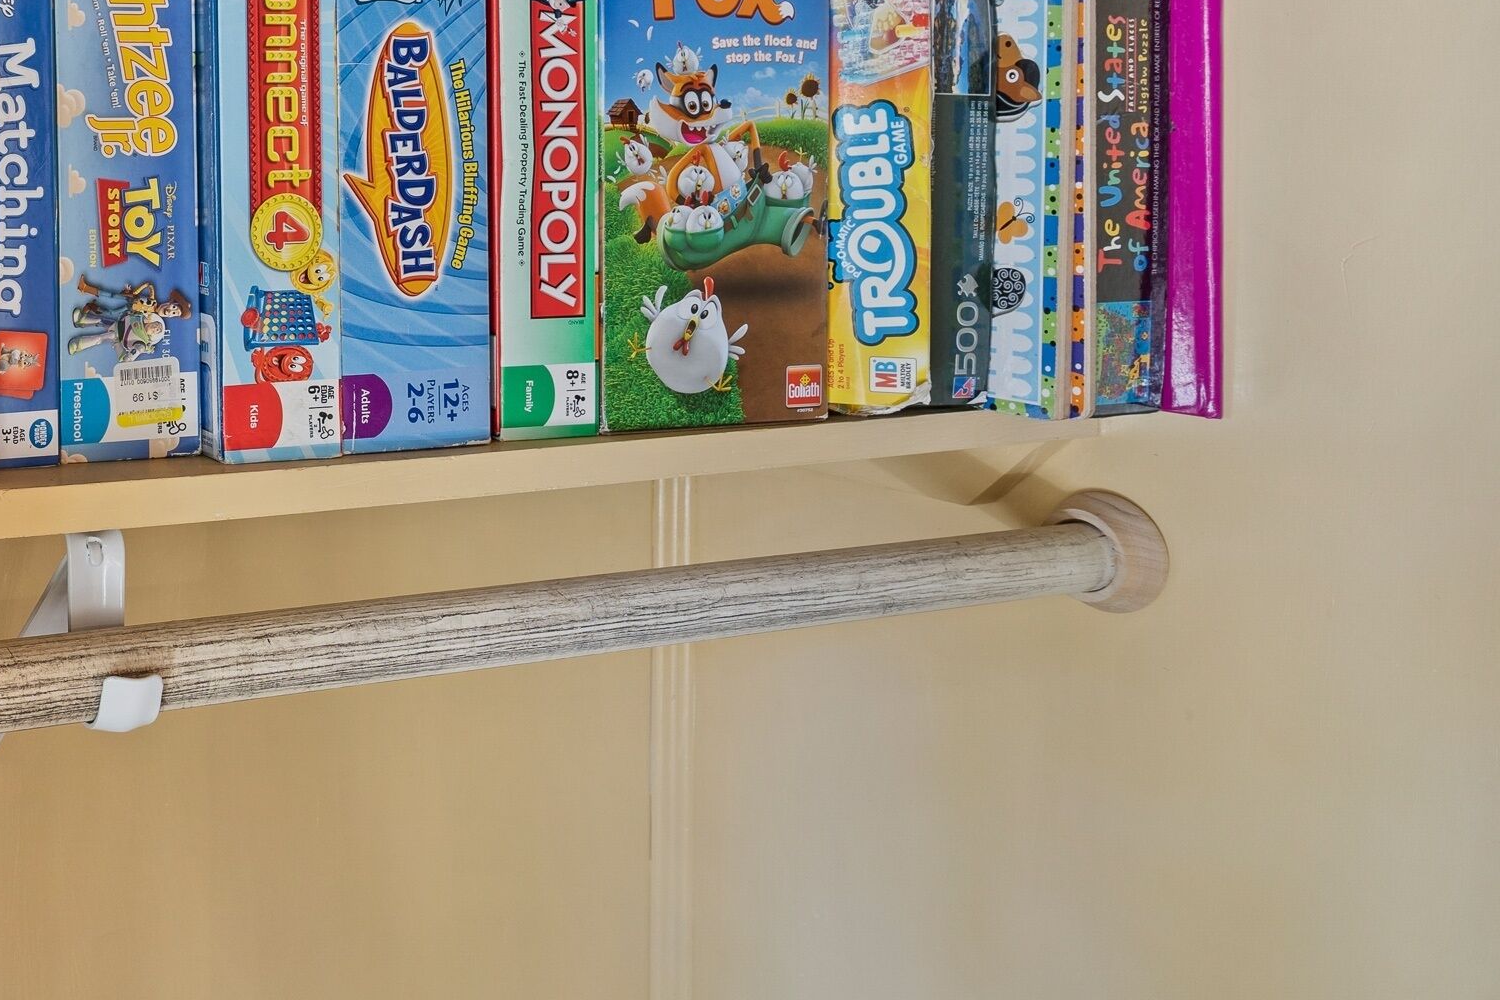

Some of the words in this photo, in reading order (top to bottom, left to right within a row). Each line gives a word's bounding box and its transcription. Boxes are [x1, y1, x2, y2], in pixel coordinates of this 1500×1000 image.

[712, 36, 739, 50] Save
[741, 34, 761, 48] the
[763, 35, 793, 48] flock
[796, 36, 818, 50] and
[726, 52, 751, 65] stop
[754, 50, 775, 64] the
[1098, 15, 1127, 102] States
[1137, 18, 1148, 62] Puzzle
[447, 57, 466, 90] The
[516, 59, 527, 78] The
[1136, 66, 1150, 113] Jigsaw
[448, 88, 478, 159] Hilarious
[515, 80, 530, 140] Fast-Dealing
[86, 113, 133, 159] Jr.
[384, 36, 436, 277] BALDERDASH
[890, 119, 908, 164] GAME
[517, 142, 528, 187] Property
[538, 11, 585, 308] MONOPOLY
[1097, 113, 1126, 207] United
[1124, 121, 1153, 230] America
[456, 160, 478, 225] Bluffing
[515, 188, 527, 225] Trading
[106, 186, 122, 259] STORY
[123, 178, 163, 267] TOY
[265, 211, 311, 254] 4
[516, 227, 526, 257] Game
[843, 108, 908, 335] TROUBLE
[88, 228, 97, 269] EDITION
[449, 225, 473, 271] Game
[1096, 217, 1123, 273] The
[1127, 237, 1149, 271] of
[954, 299, 980, 375] 500
[307, 384, 320, 401] 6+
[523, 379, 533, 412] Family
[565, 369, 579, 386] 8+
[789, 383, 820, 398] Goliath
[873, 360, 898, 388] MB
[904, 362, 912, 389] BRADLEY
[73, 382, 84, 442] Preschool
[249, 404, 258, 429] Kids
[359, 387, 370, 425] Adults
[443, 377, 459, 422] 12+
